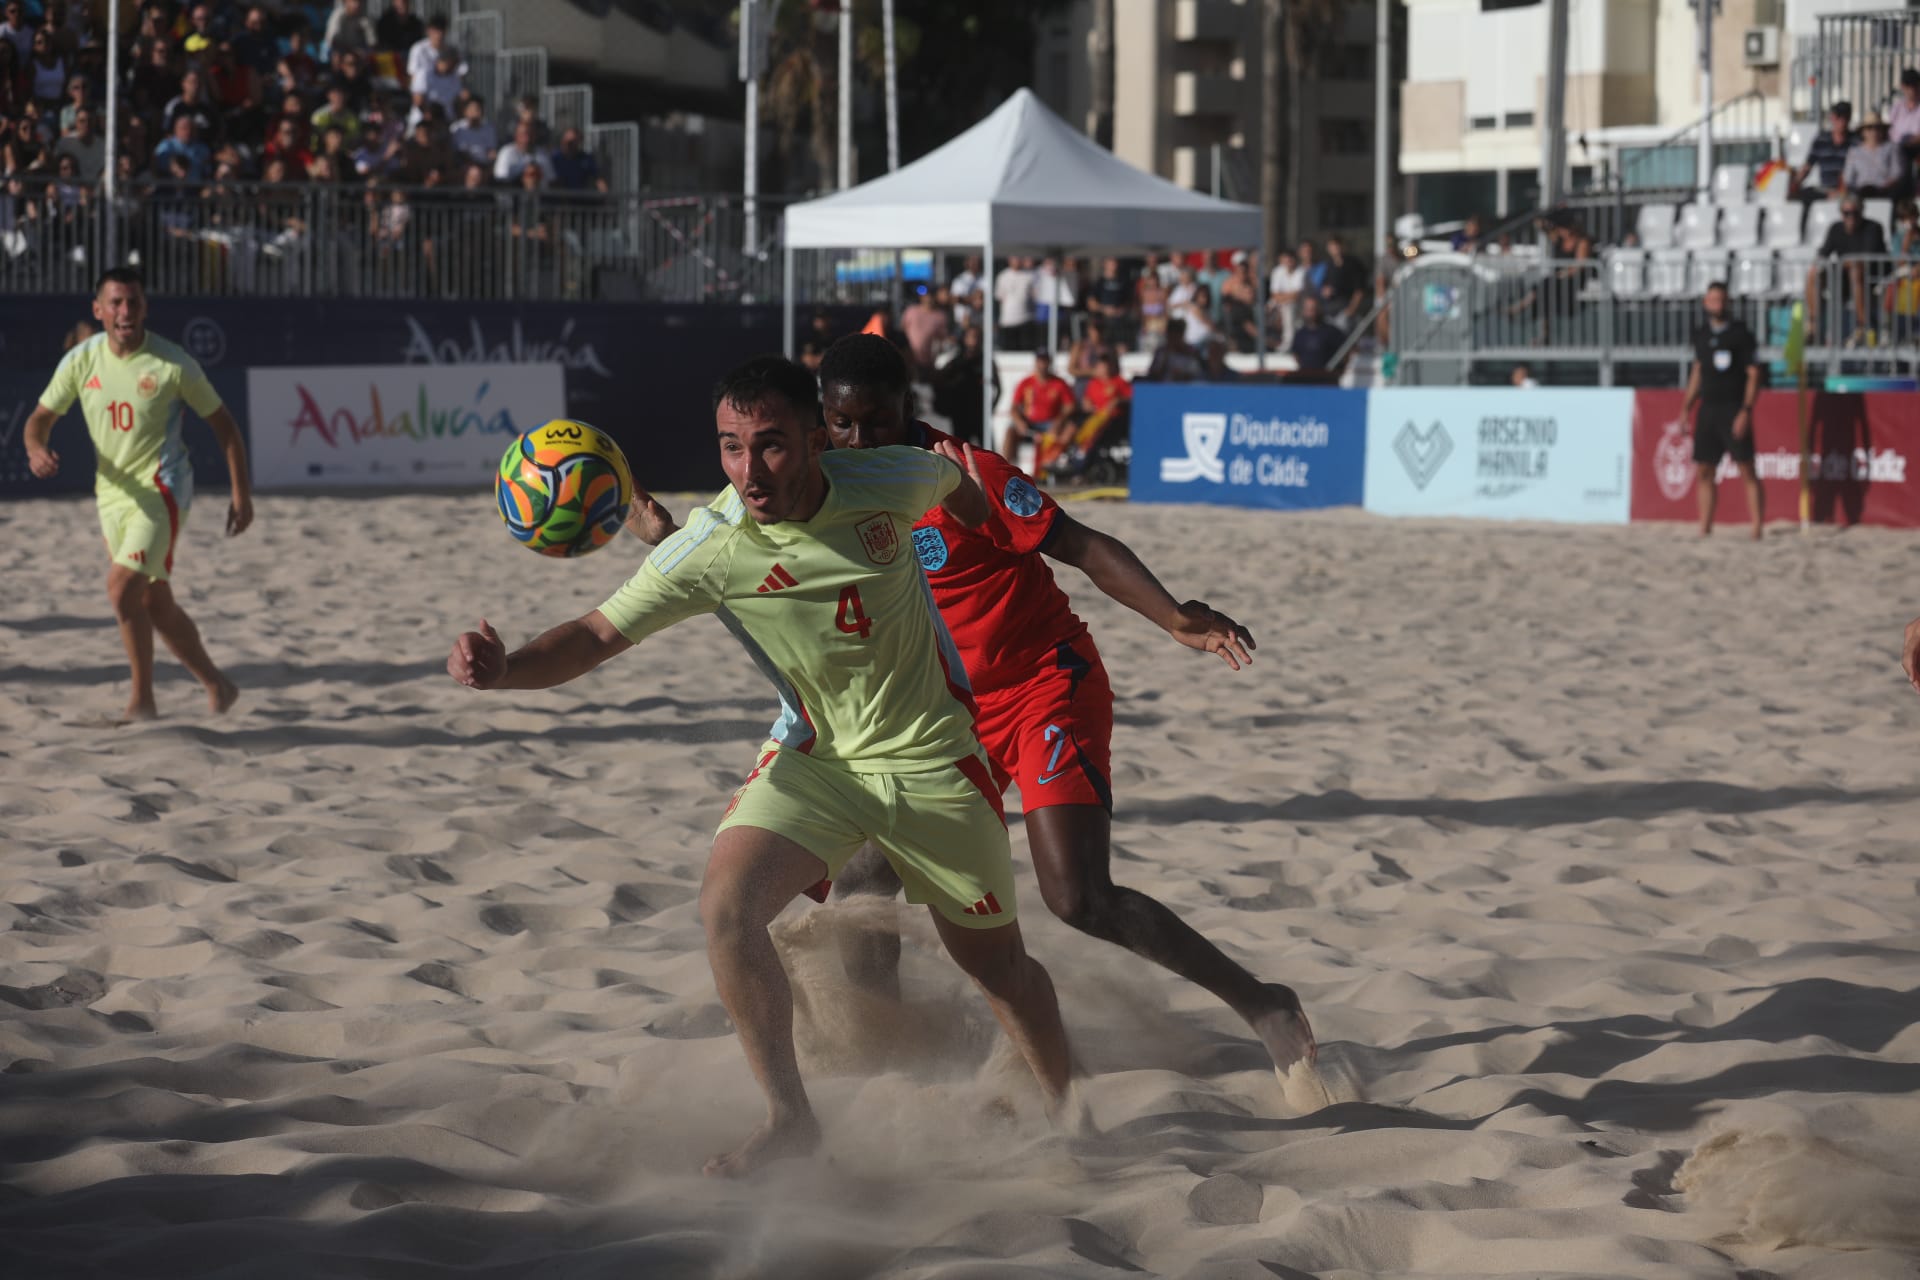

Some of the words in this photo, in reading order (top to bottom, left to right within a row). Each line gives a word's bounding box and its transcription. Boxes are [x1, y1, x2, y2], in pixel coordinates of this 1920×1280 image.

[107, 400, 134, 432] 10
[289, 380, 522, 448] Andalucía
[1230, 413, 1328, 450] Diputación
[1478, 416, 1557, 446] ARSENIO
[1229, 453, 1253, 485] de
[1256, 453, 1309, 487] Cádiz
[835, 584, 872, 639] 4
[1044, 724, 1065, 772] 7
